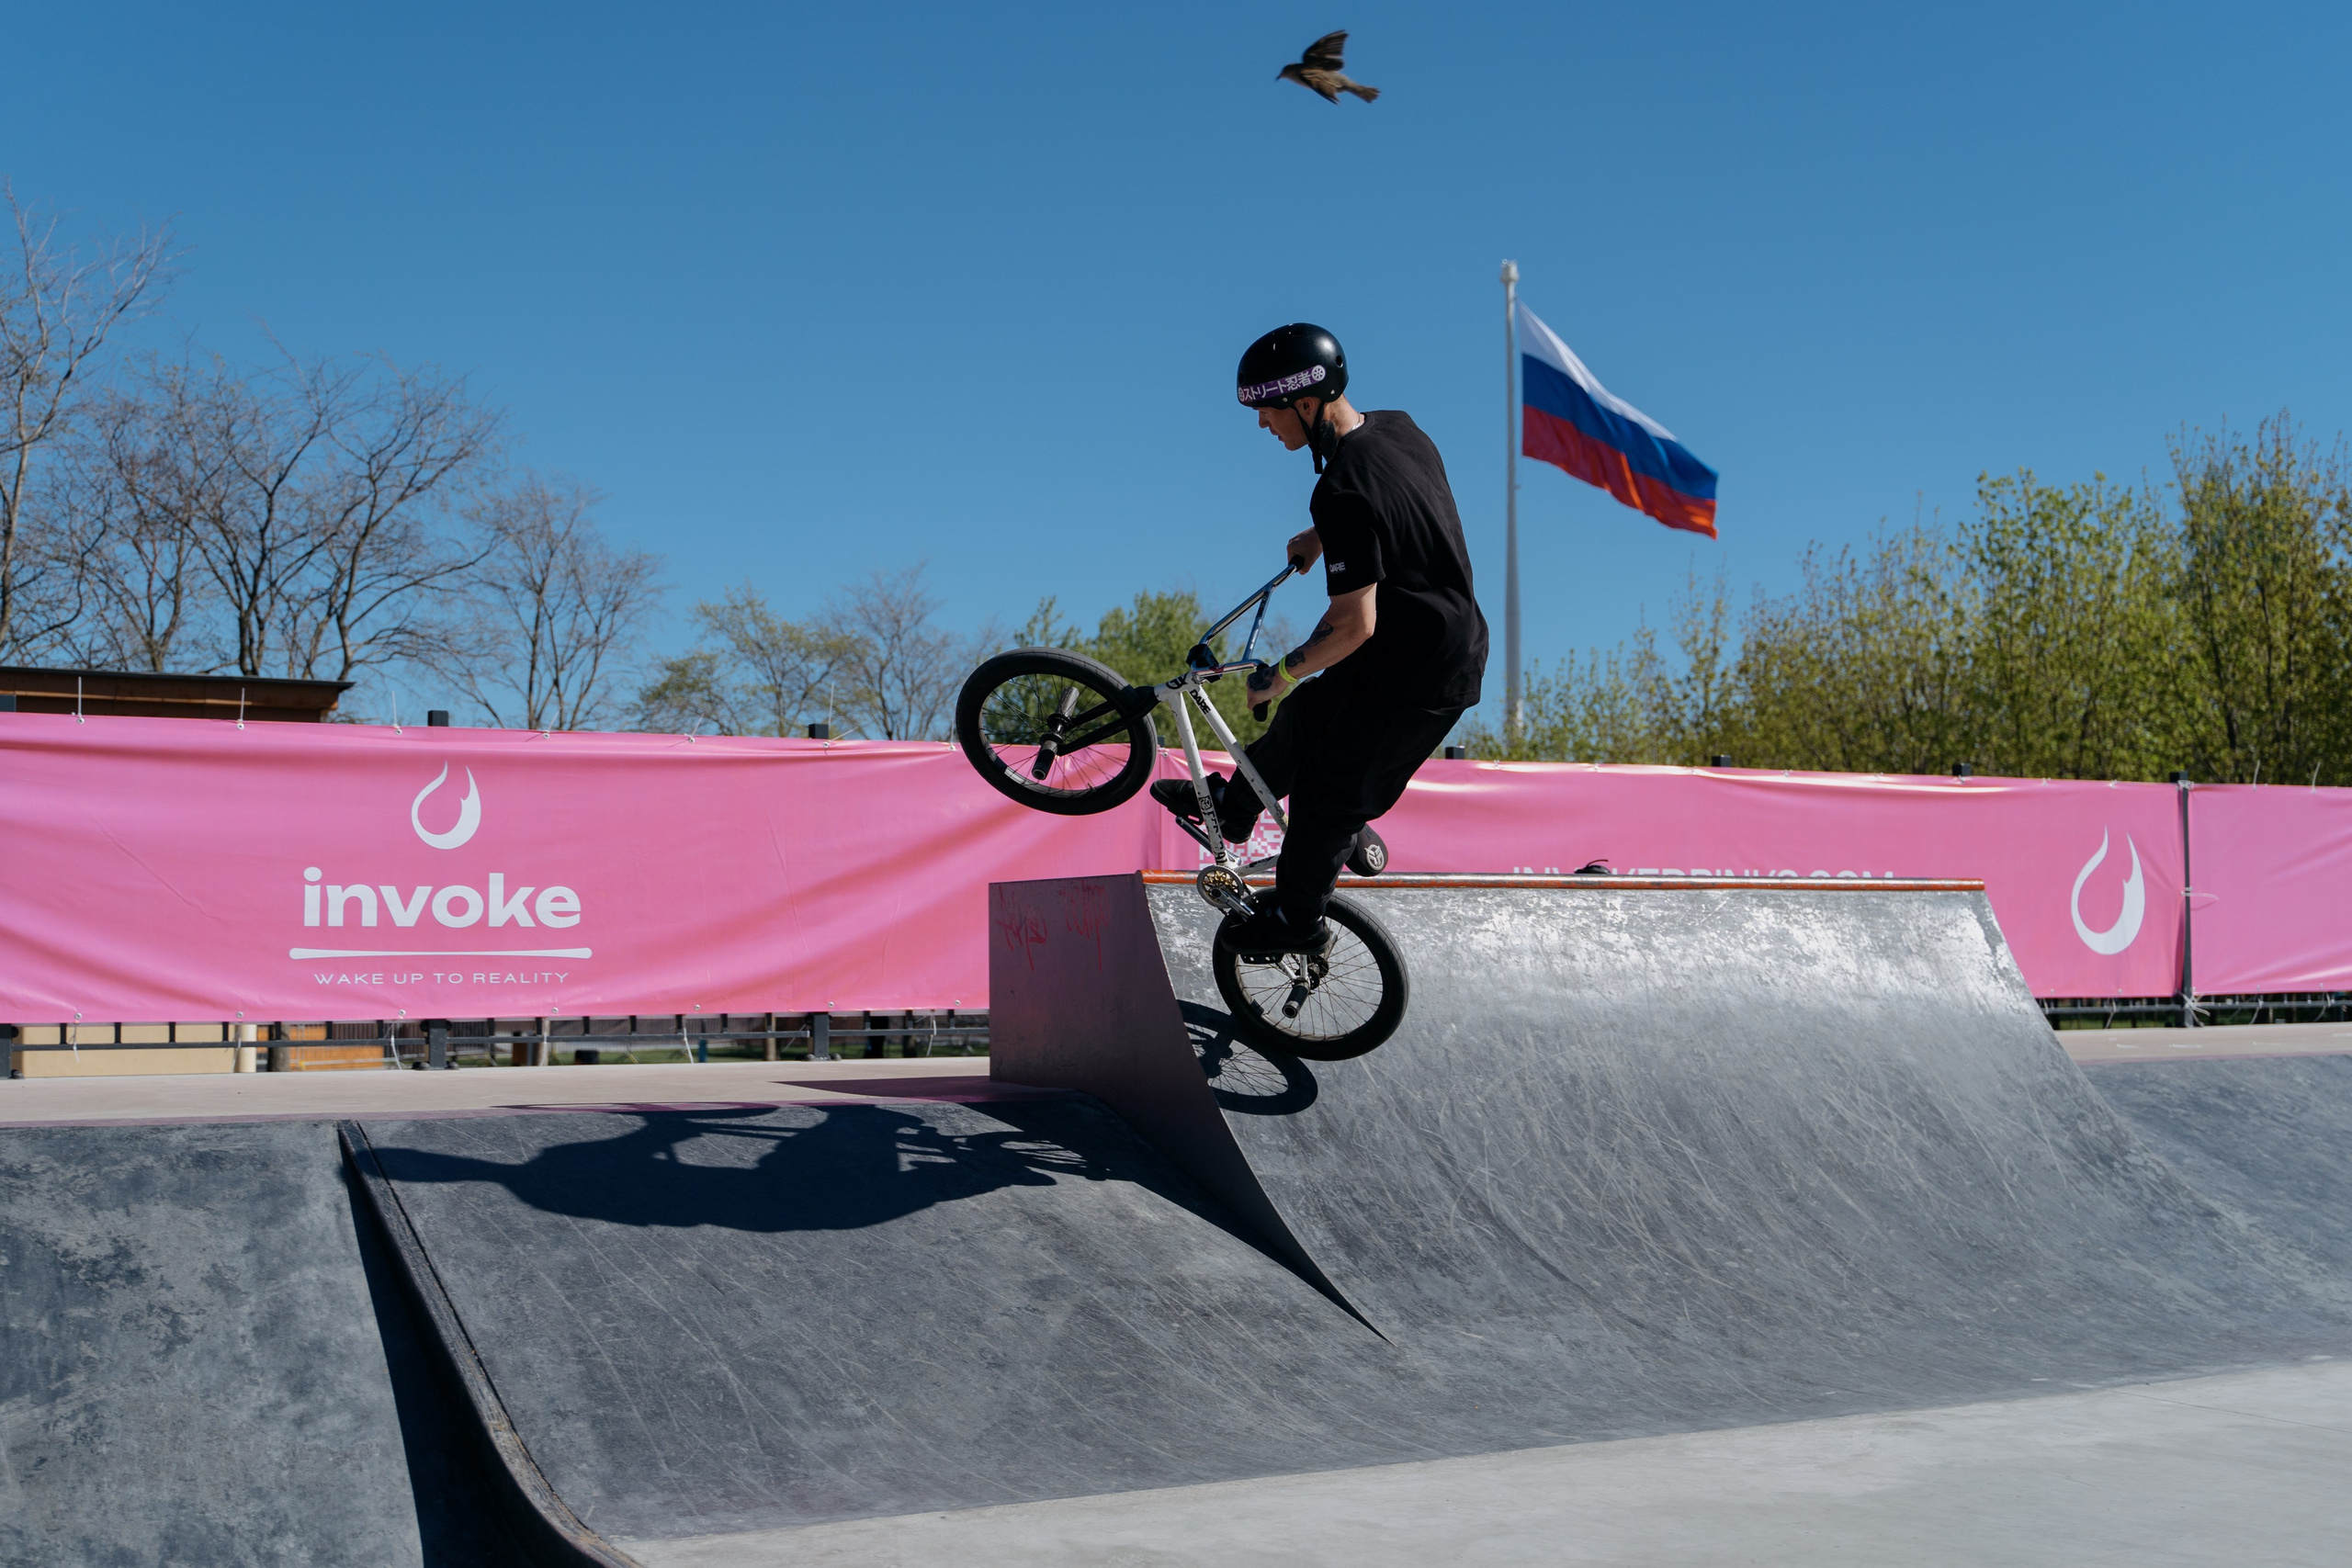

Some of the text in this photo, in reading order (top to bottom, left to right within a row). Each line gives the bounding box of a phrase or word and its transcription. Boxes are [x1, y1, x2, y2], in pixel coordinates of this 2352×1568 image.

[1243, 371, 1312, 400] ストリート忍者
[1190, 689, 1211, 715] DARE
[303, 866, 581, 929] invoke
[314, 972, 569, 985] WAKE UP TO REALITY
